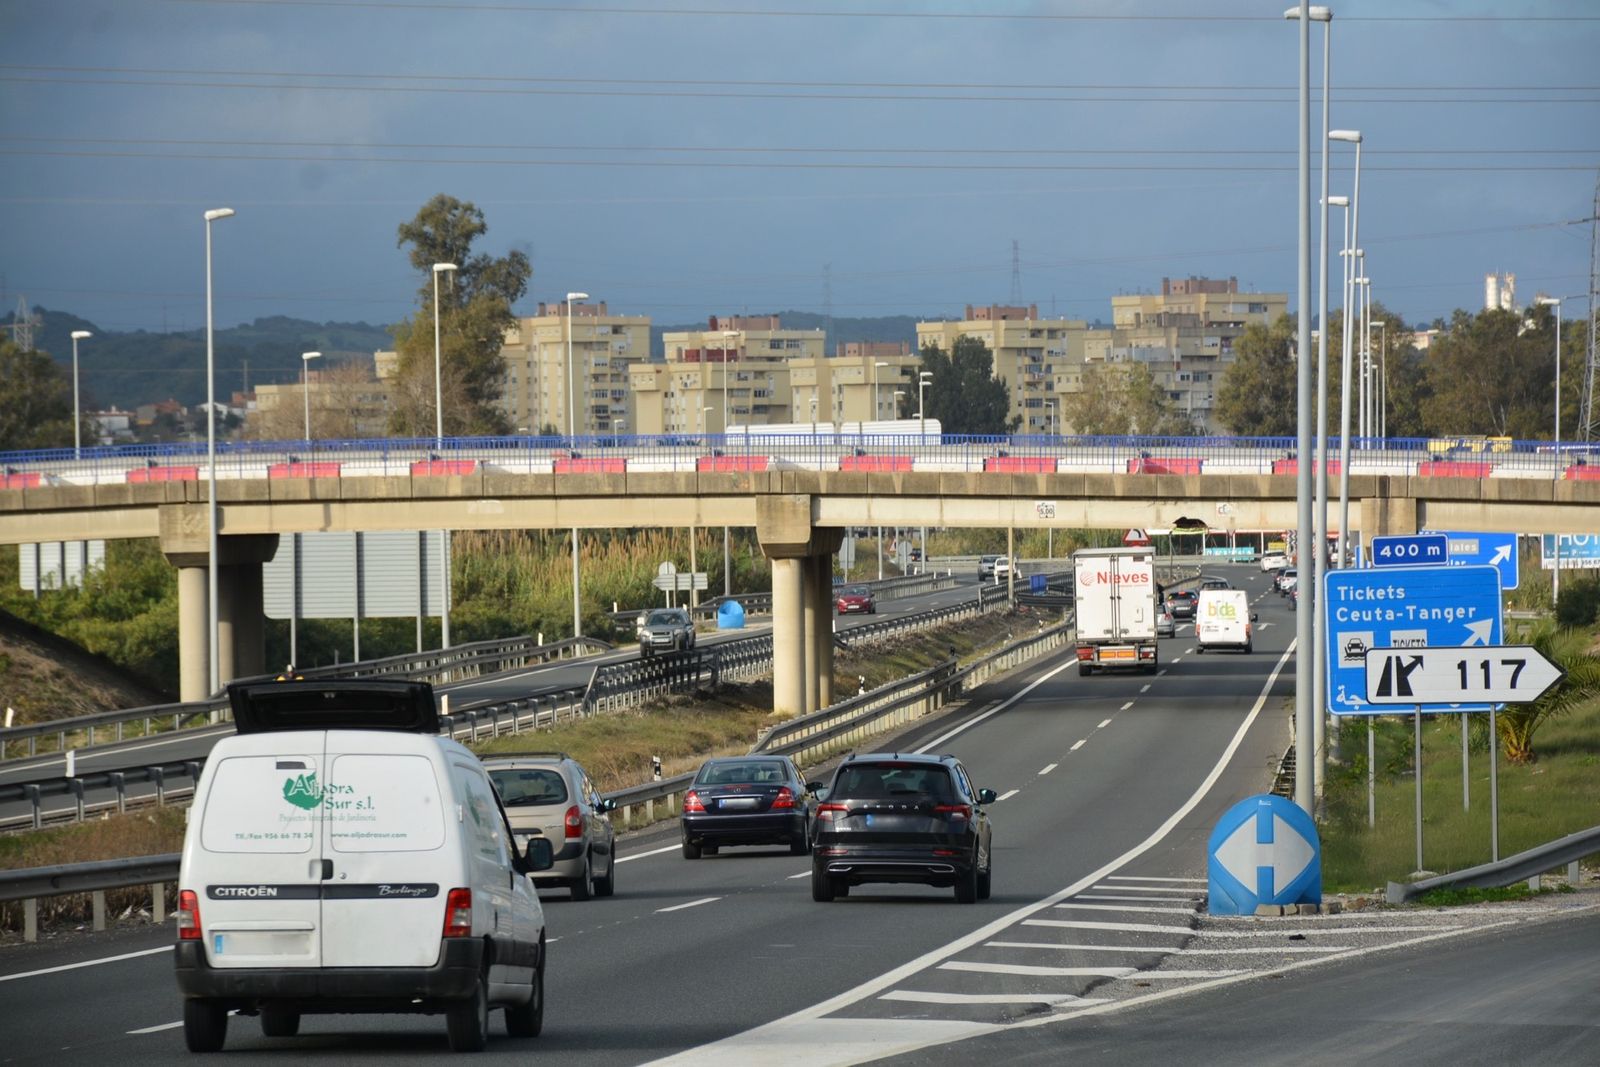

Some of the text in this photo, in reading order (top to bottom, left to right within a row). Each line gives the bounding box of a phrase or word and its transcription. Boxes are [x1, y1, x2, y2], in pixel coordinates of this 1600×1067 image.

[1380, 544, 1440, 557] 400 m
[1097, 571, 1149, 584] Nieves
[1337, 585, 1405, 601] Tickets
[1336, 605, 1477, 623] Ceuta-Tanger
[1457, 659, 1527, 690] 117
[287, 773, 354, 800] Aljadra
[325, 796, 353, 810] Sur
[214, 886, 277, 897] CITROËN
[378, 884, 428, 896] Berlingo
